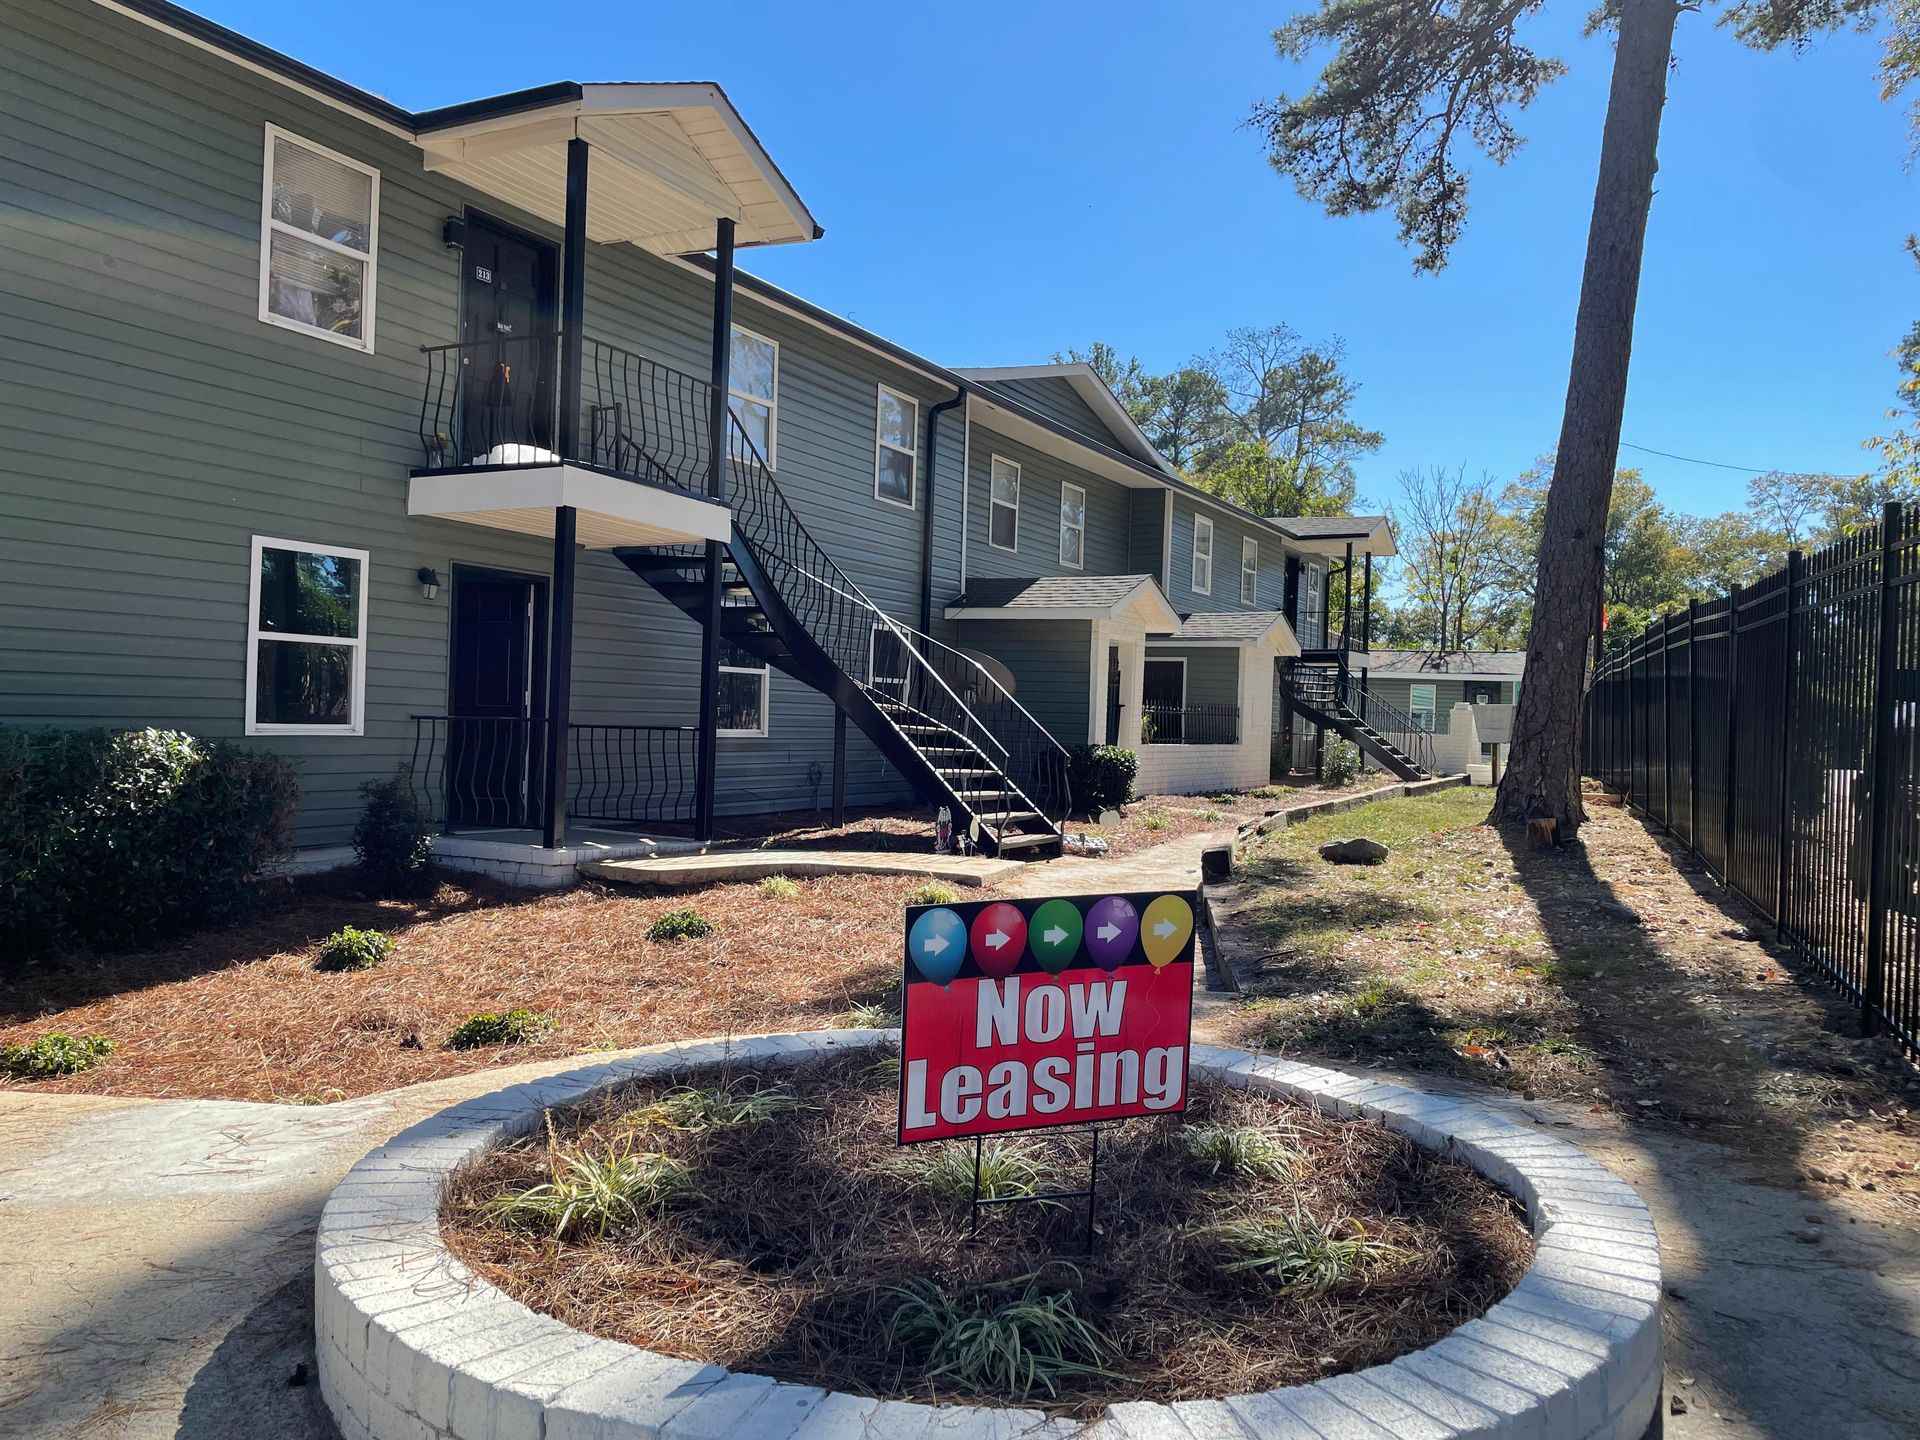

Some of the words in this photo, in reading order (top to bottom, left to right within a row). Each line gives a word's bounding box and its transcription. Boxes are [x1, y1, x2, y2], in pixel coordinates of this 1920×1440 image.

[478, 269, 490, 280] 213
[976, 976, 1128, 1049] Now
[904, 1041, 1184, 1129] Leasing
